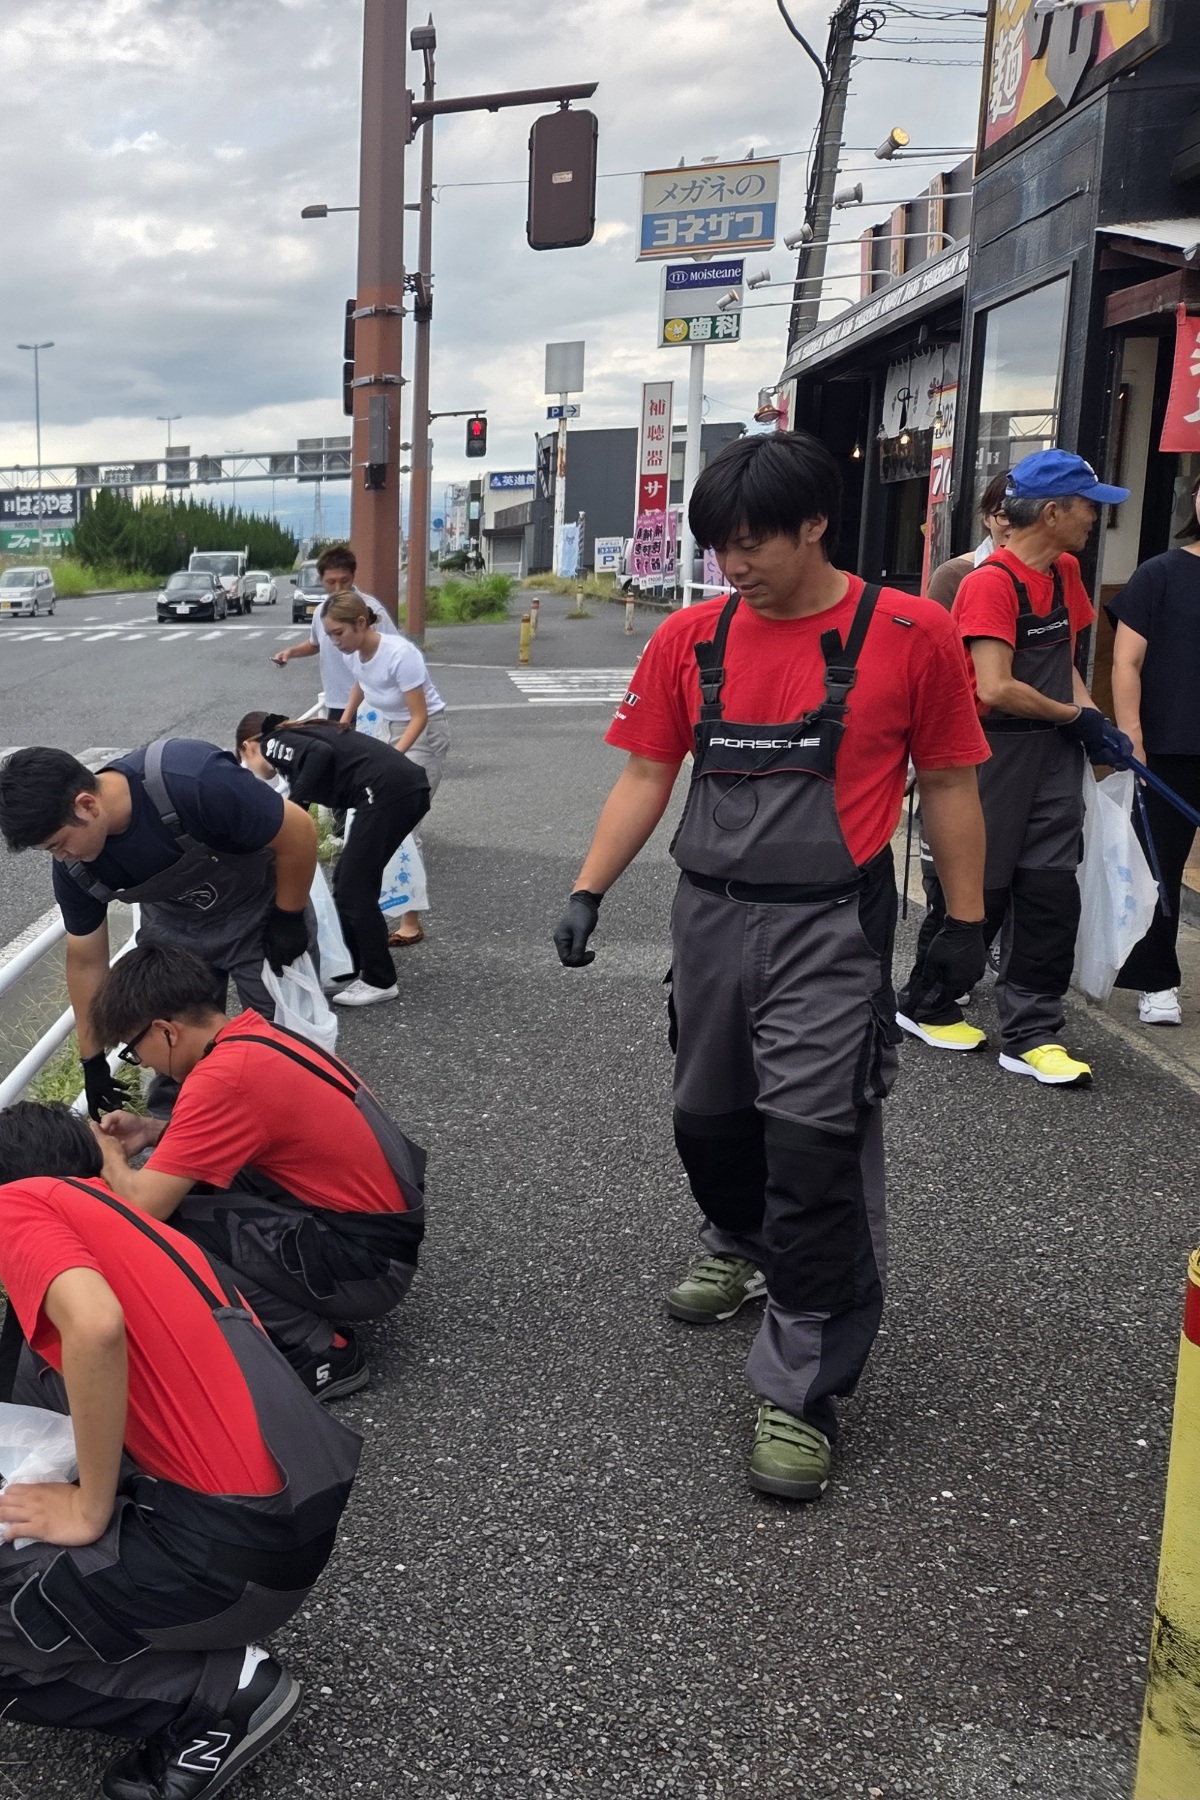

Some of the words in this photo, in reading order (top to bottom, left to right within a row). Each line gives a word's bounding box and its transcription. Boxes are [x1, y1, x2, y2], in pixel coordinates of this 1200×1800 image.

[654, 174, 766, 207] メガネの
[652, 211, 764, 246] ヨネザワ
[690, 267, 742, 281] Moisteane
[689, 315, 738, 340] 歯科
[551, 407, 560, 417] P
[15, 494, 73, 516] はるやま
[603, 556, 615, 565] P
[709, 737, 821, 749] PORSCHE
